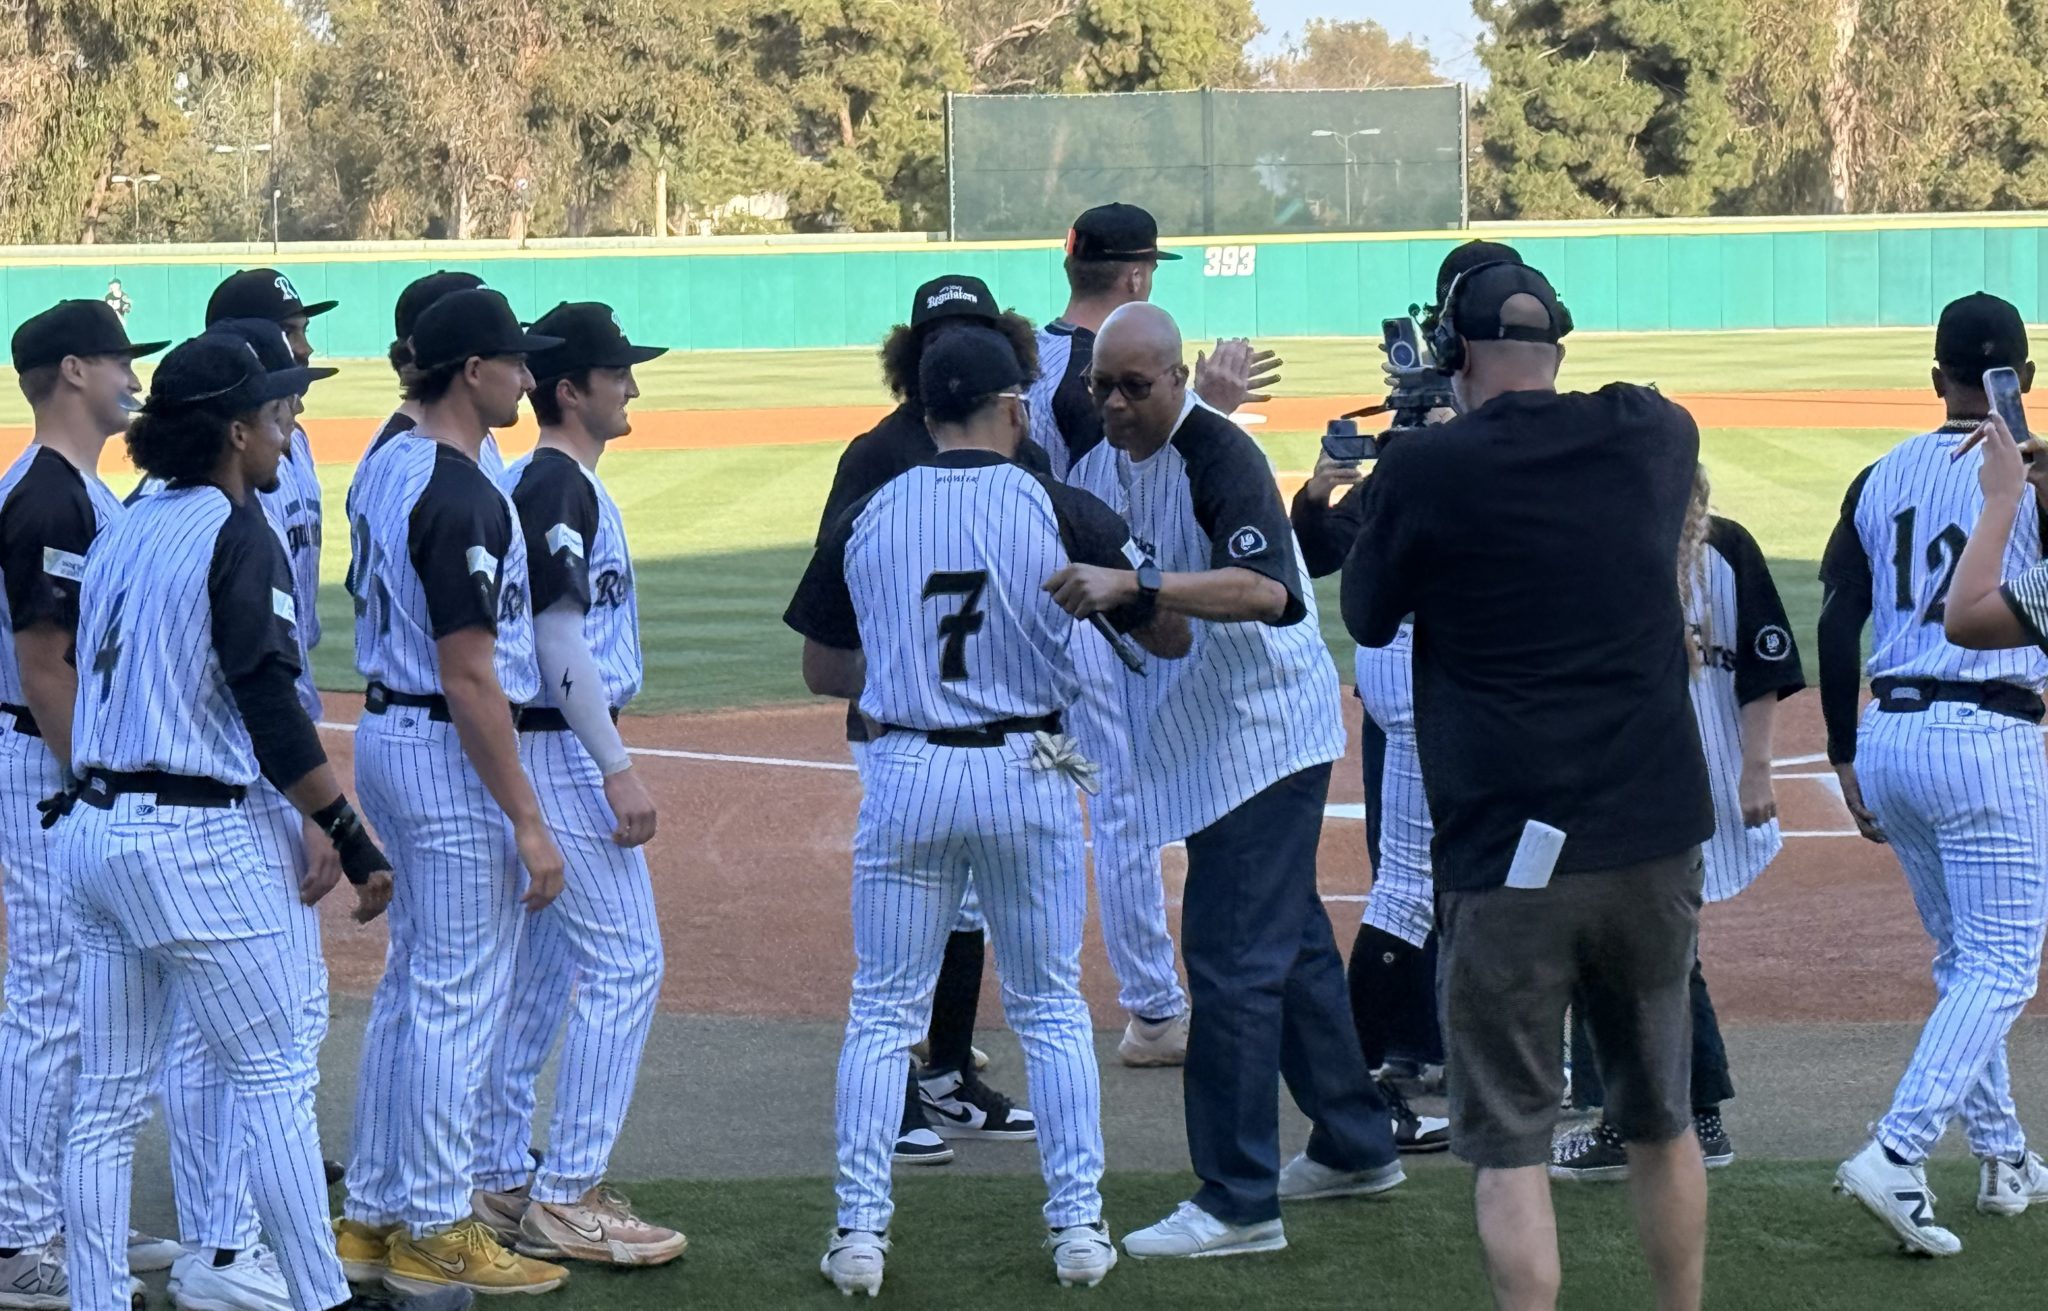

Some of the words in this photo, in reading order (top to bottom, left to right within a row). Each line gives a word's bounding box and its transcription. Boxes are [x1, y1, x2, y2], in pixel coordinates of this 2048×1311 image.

[1203, 246, 1256, 277] 393
[274, 276, 299, 300] R
[927, 288, 978, 309] Regulators
[1893, 505, 1968, 626] 12
[922, 569, 988, 682] 7
